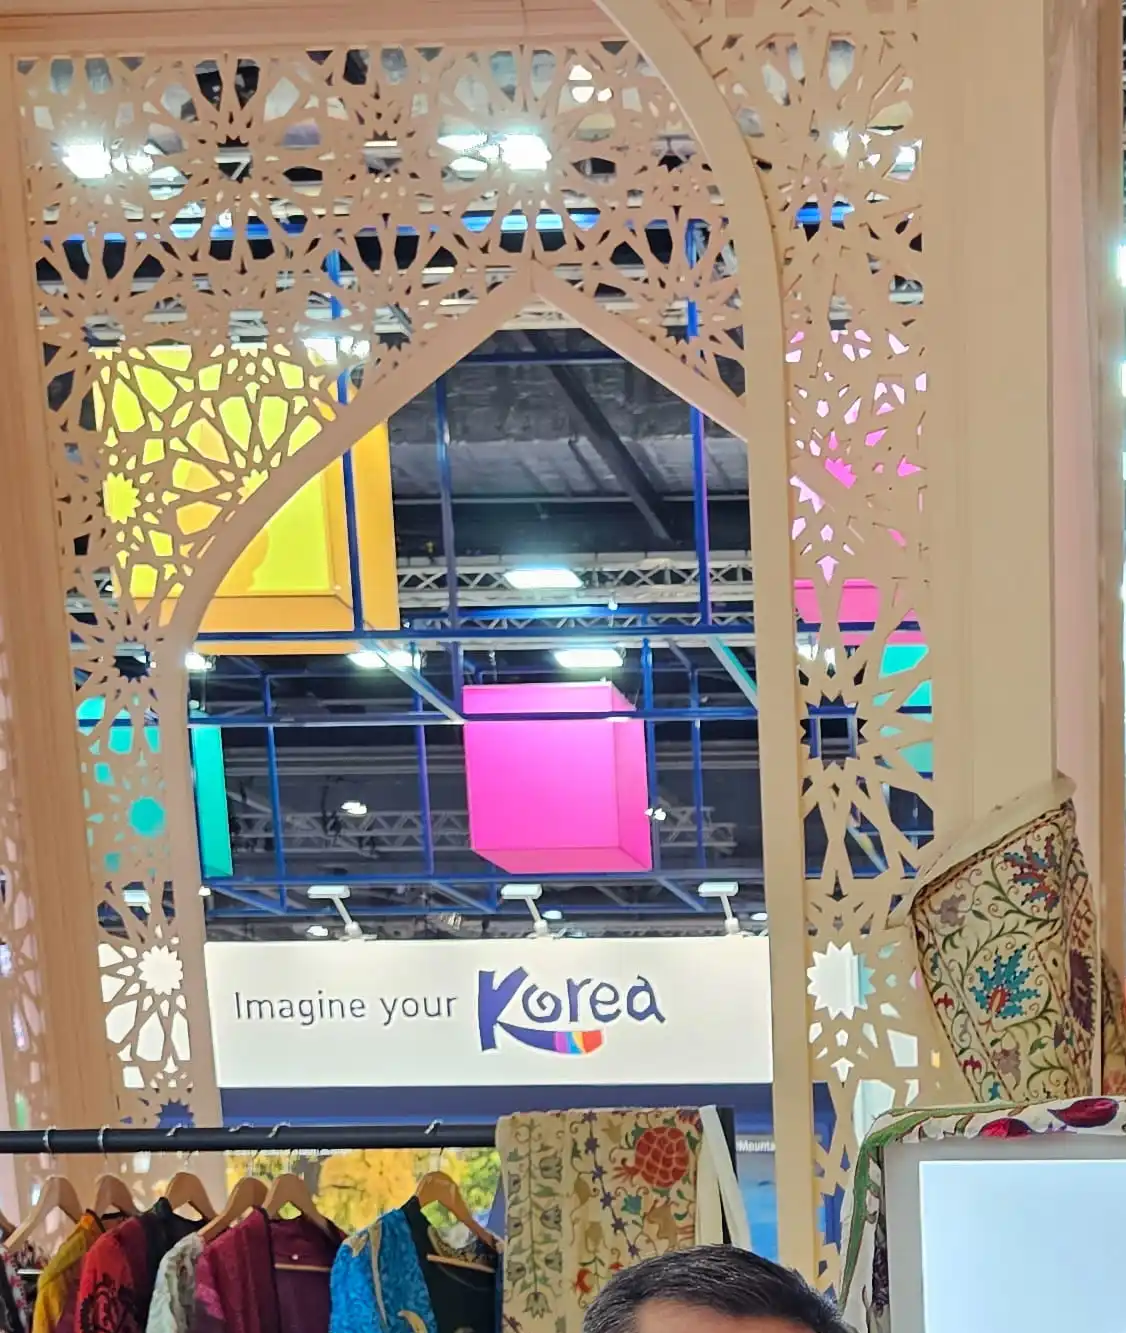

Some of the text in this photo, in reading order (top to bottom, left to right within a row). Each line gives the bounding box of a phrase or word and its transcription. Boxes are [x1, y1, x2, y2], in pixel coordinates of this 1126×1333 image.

[235, 966, 666, 1055] Imagine your Korea
